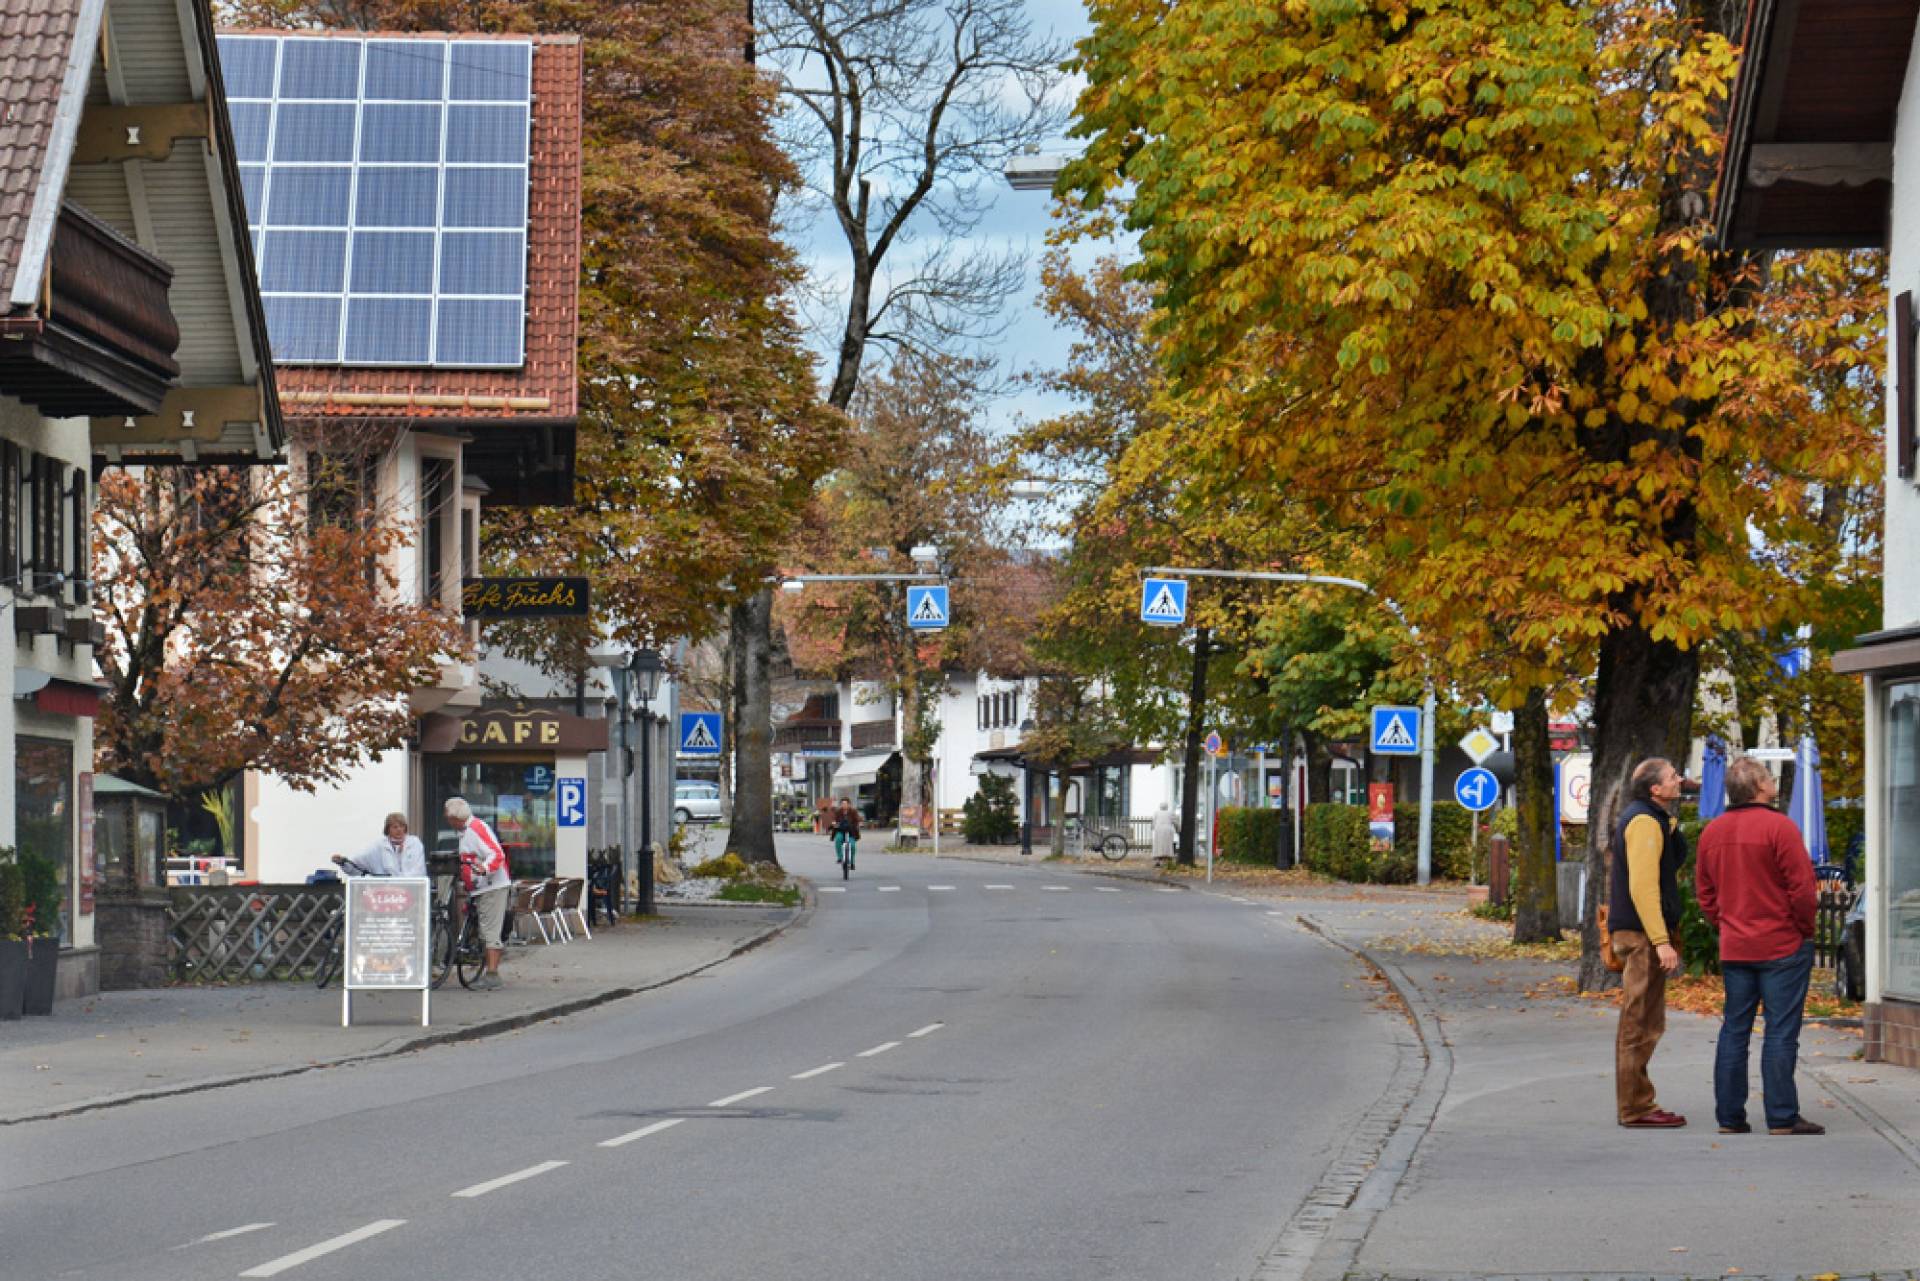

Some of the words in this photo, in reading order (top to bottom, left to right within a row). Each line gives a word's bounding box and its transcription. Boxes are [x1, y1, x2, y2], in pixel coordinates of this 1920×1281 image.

[460, 719, 560, 744] CAFE
[534, 766, 546, 785] P
[562, 785, 581, 817] P
